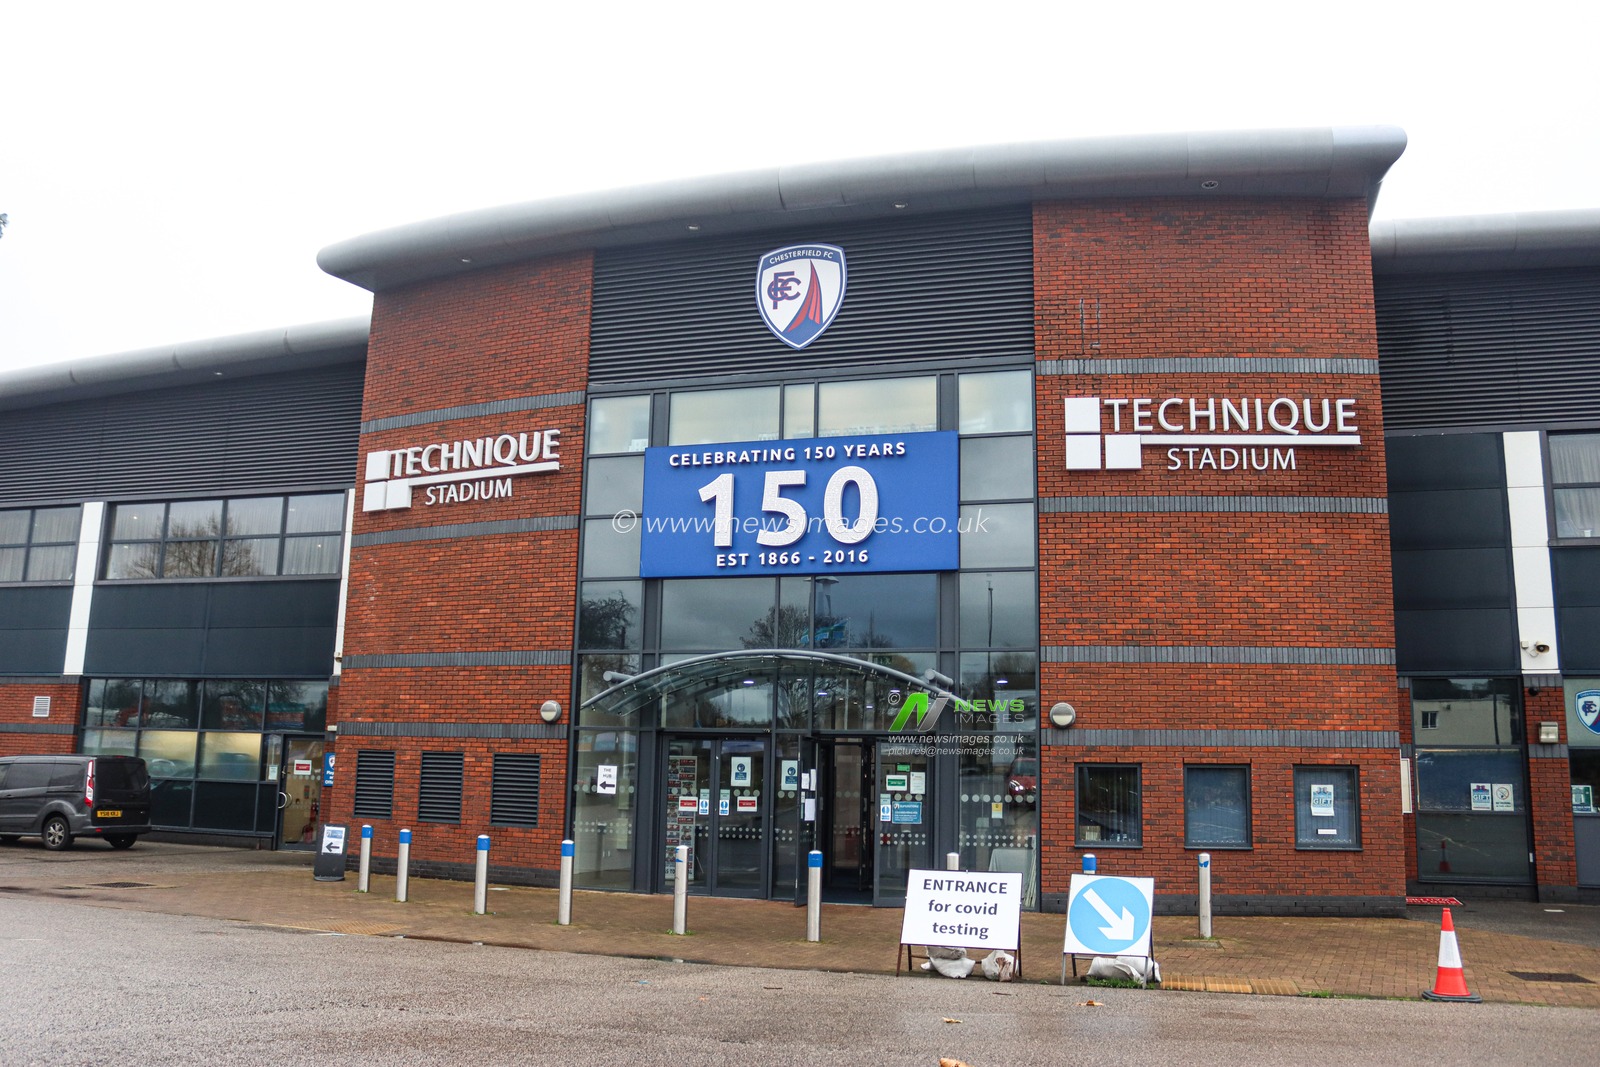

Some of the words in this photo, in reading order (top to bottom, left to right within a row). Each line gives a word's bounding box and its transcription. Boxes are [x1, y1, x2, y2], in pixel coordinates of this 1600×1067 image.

[769, 249, 822, 265] CHESTERFIELD
[823, 252, 834, 260] FC
[1104, 397, 1358, 435] TECHNIQUE
[390, 429, 561, 477] TECHNIQUE
[669, 447, 796, 467] CELEBRATING
[803, 445, 836, 460] 150
[843, 442, 907, 458] YEARS
[1167, 448, 1297, 470] STADIUM
[425, 478, 513, 506] STADIUM
[698, 465, 879, 547] 150
[716, 552, 749, 567] EST
[758, 551, 800, 565] 1866
[823, 549, 869, 564] 2016
[923, 878, 1008, 894] ENTRANCE
[928, 899, 951, 913] for
[955, 902, 998, 916] covid
[932, 922, 989, 940] testing
